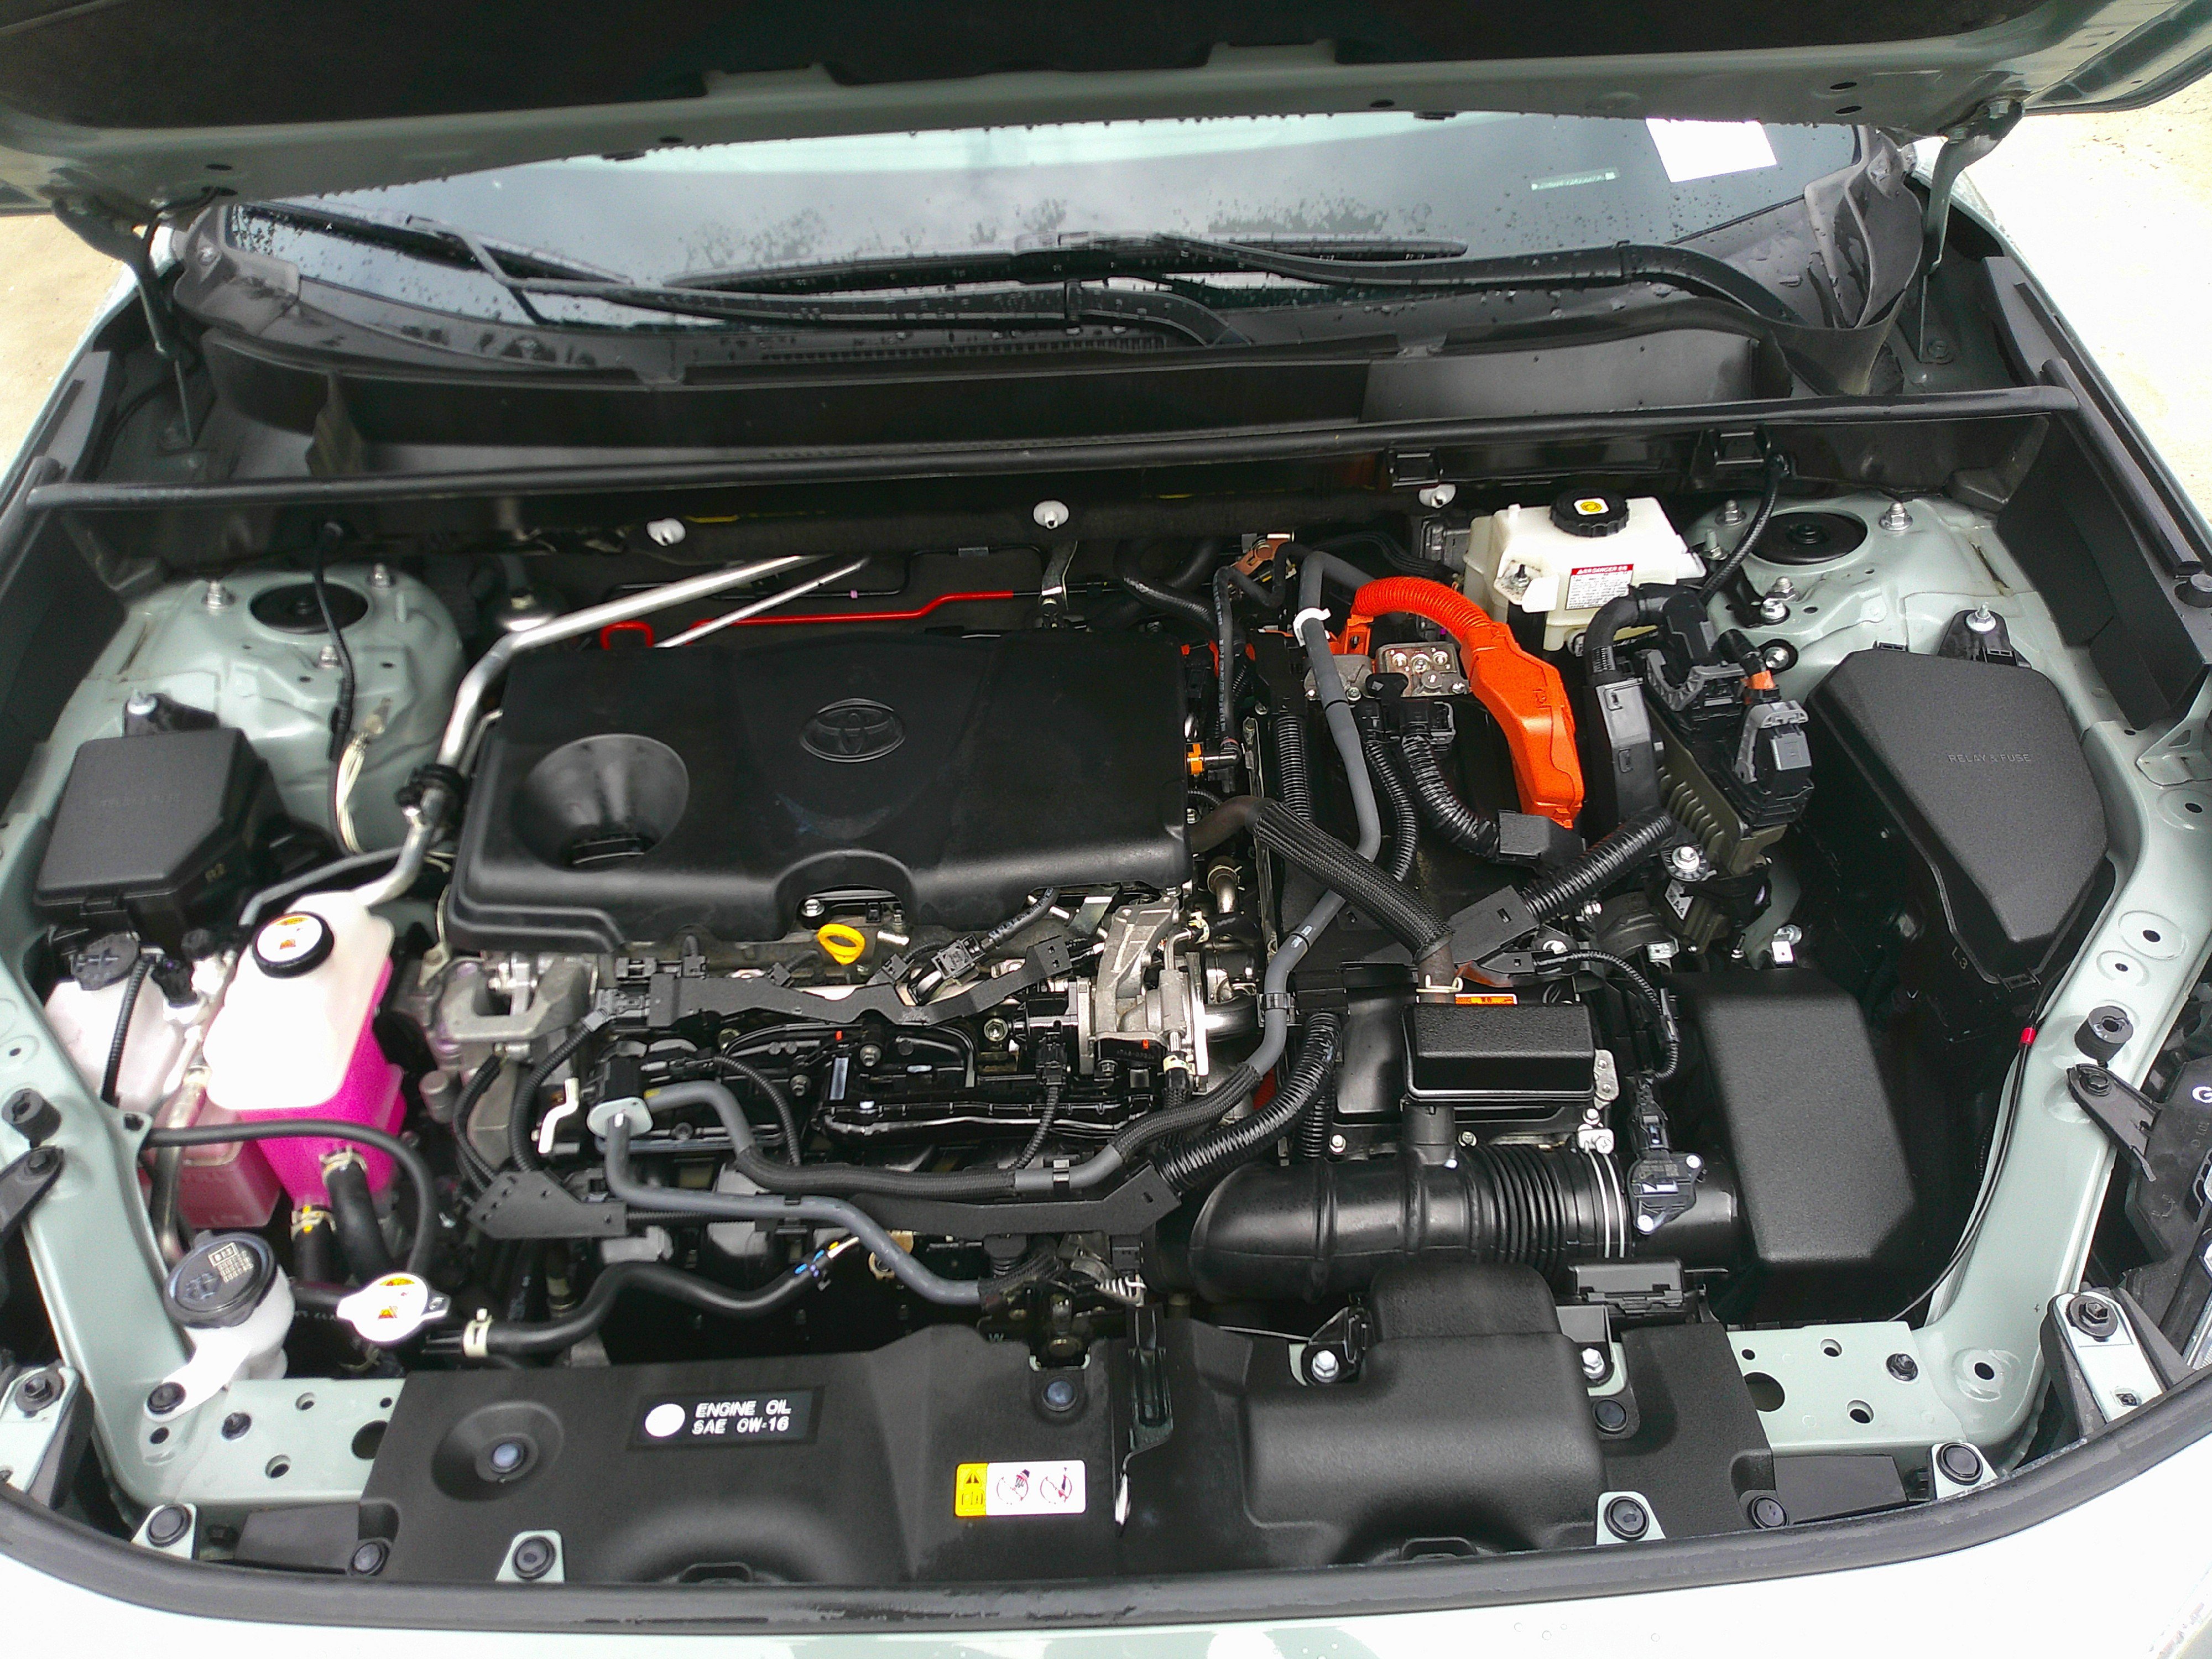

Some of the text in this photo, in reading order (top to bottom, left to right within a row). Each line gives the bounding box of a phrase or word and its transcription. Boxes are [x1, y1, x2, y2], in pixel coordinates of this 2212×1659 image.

[1948, 754, 1986, 763] RELAY
[2000, 754, 2031, 762] FUSE
[695, 1399, 792, 1418] ENGINE OIL
[691, 1416, 790, 1435] SAE 0W-16
